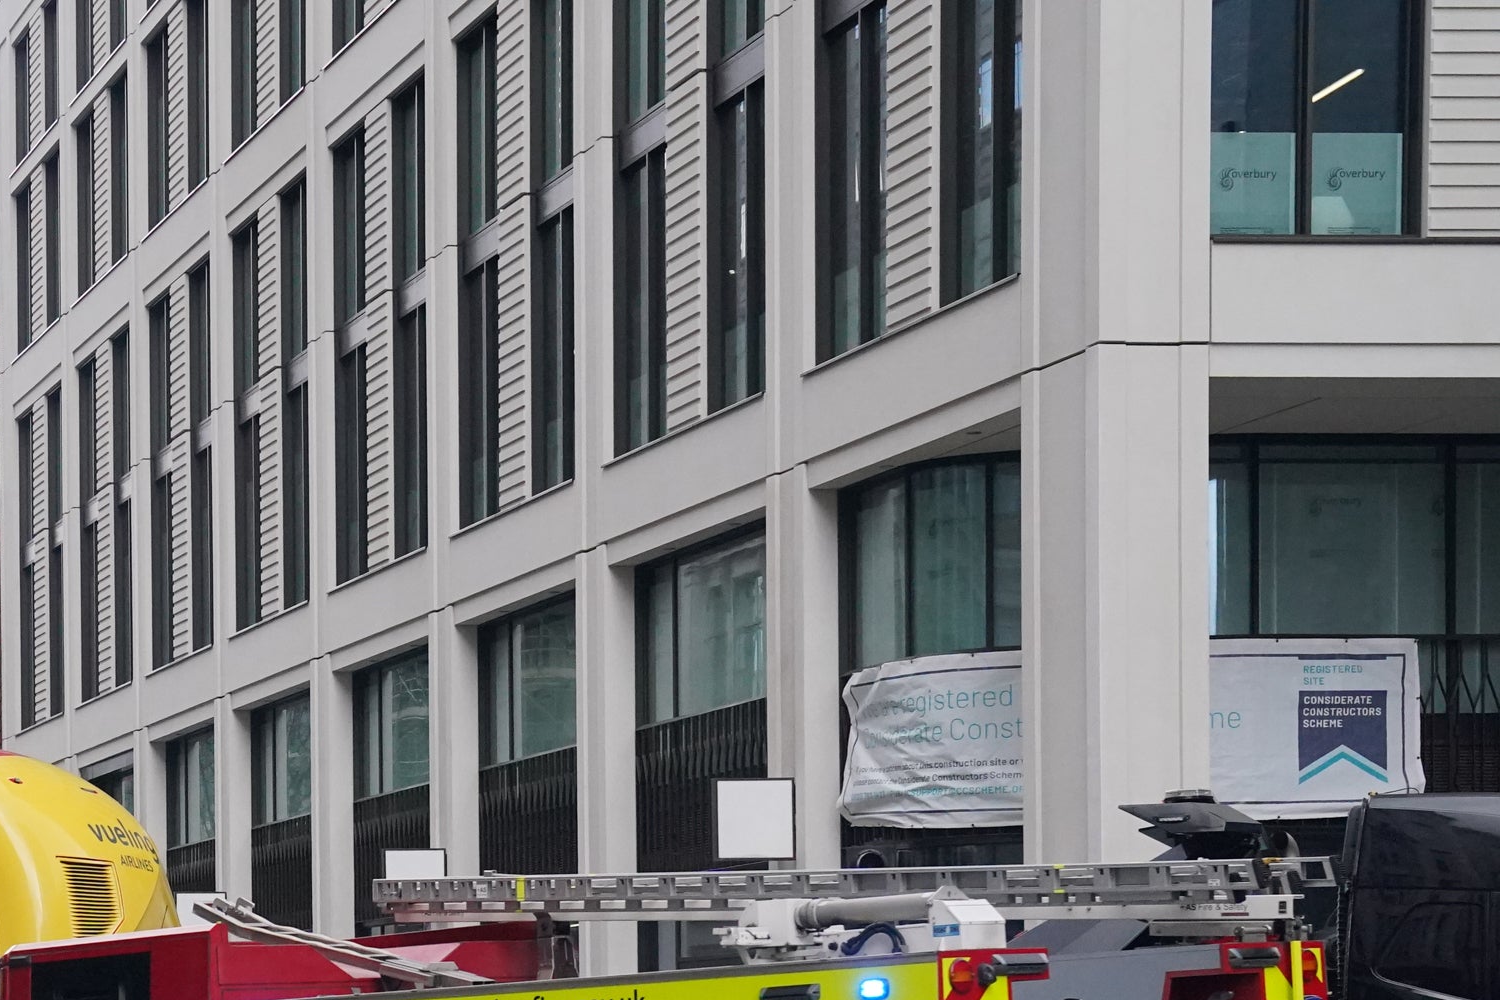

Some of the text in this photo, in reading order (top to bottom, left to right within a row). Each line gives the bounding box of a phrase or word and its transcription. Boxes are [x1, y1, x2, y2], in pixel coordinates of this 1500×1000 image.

[1231, 169, 1277, 181] overbury
[1339, 168, 1386, 181] overbury
[1303, 664, 1363, 674] REGISTERED
[1303, 677, 1325, 686] SITE
[902, 684, 1013, 718] registered
[1303, 695, 1373, 705] CONSIDERATE
[1302, 707, 1382, 717] CONSTRUCTORS
[1302, 719, 1344, 729] SCHEME
[990, 756, 1007, 766] site
[1009, 756, 1019, 766] or
[932, 772, 988, 782] Constructors
[990, 770, 1022, 780] Schem
[87, 818, 159, 865] vueling
[120, 854, 154, 873] AIRLINES
